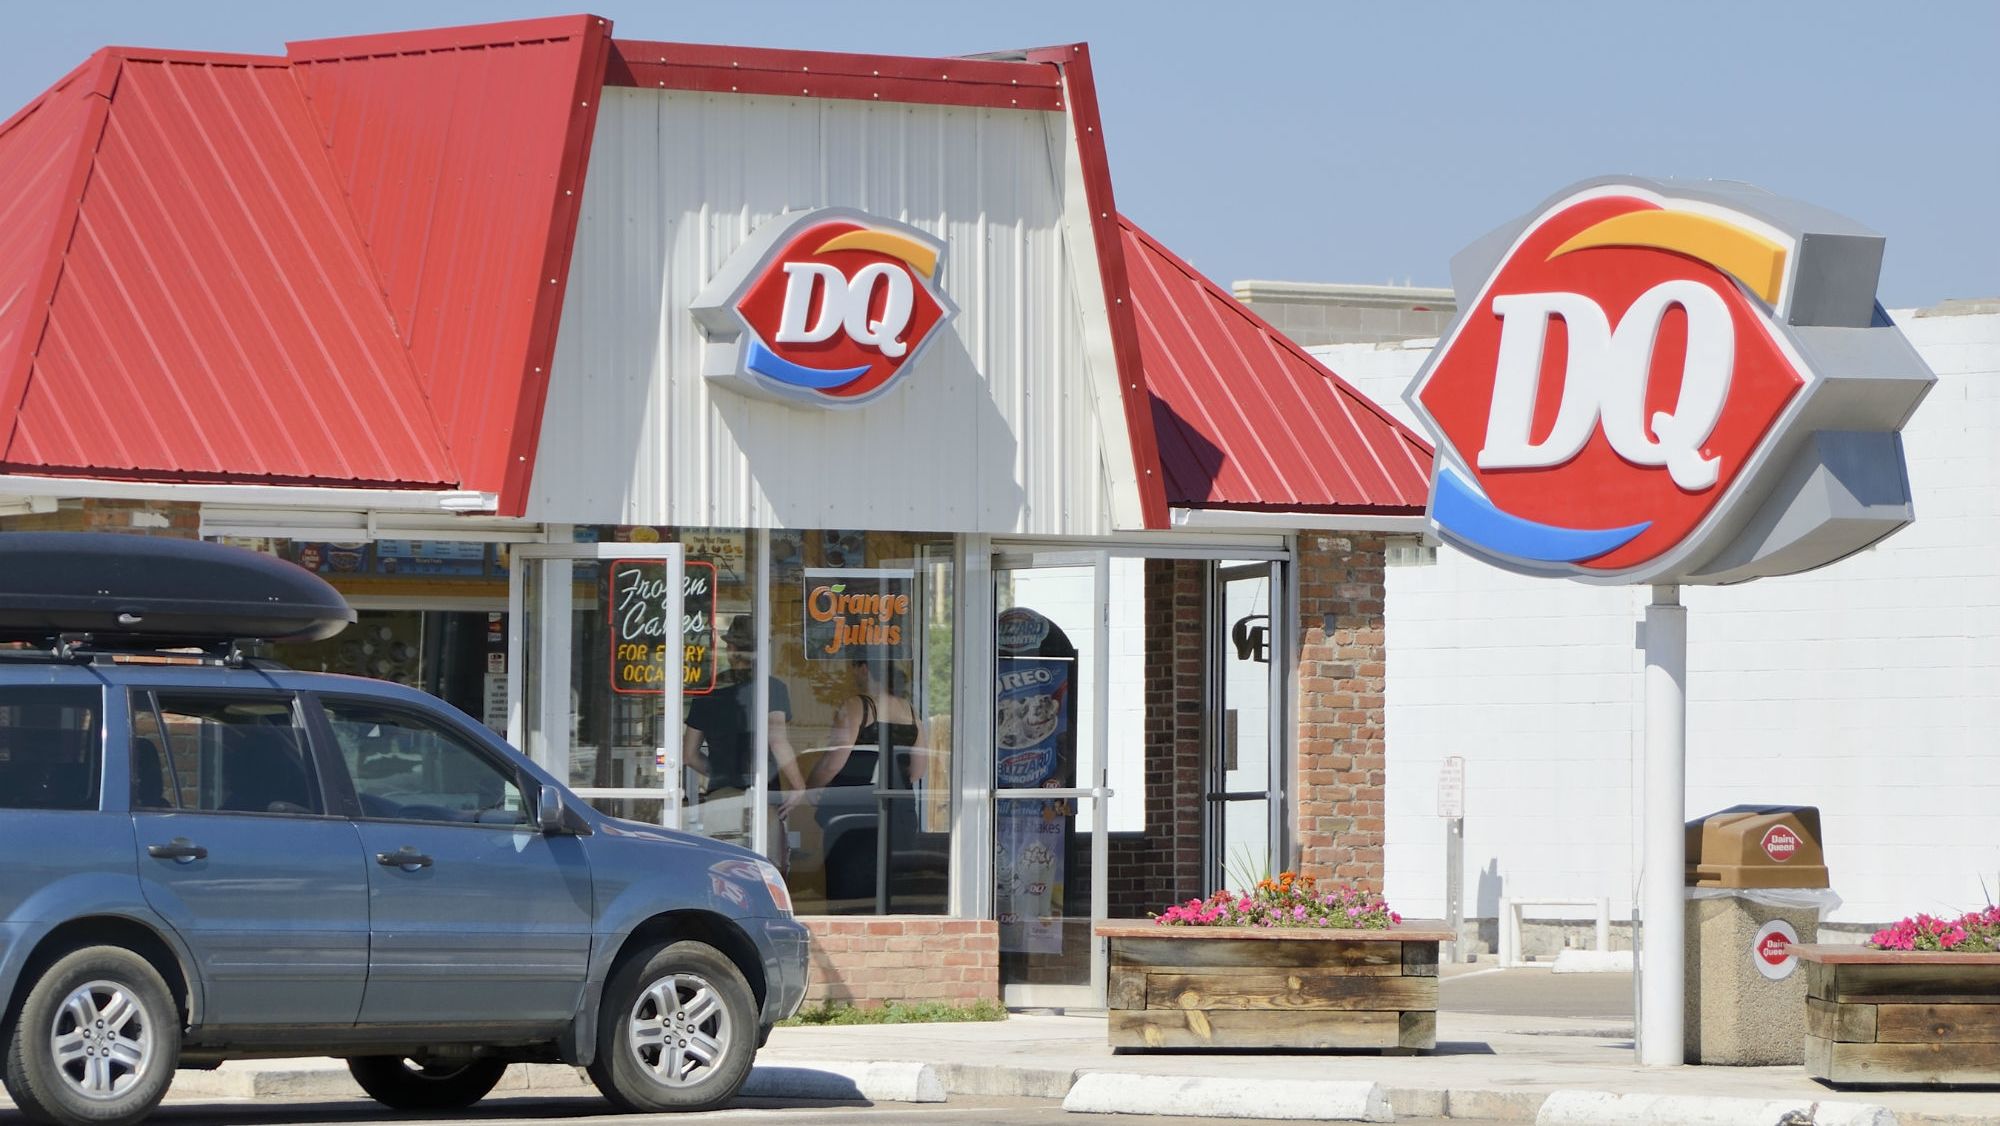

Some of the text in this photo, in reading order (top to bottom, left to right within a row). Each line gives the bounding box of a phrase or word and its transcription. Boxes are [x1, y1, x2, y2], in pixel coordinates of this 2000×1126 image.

[775, 262, 914, 358] DQ
[1477, 279, 1735, 491] DQ
[618, 569, 707, 610] Froen
[808, 585, 910, 622] Orange
[622, 601, 704, 640] Caes
[824, 616, 902, 654] Julius
[617, 644, 706, 662] FOR ERY
[623, 664, 701, 683] OCCAON
[1767, 843, 1794, 853] Queen
[1772, 834, 1795, 845] Dairy
